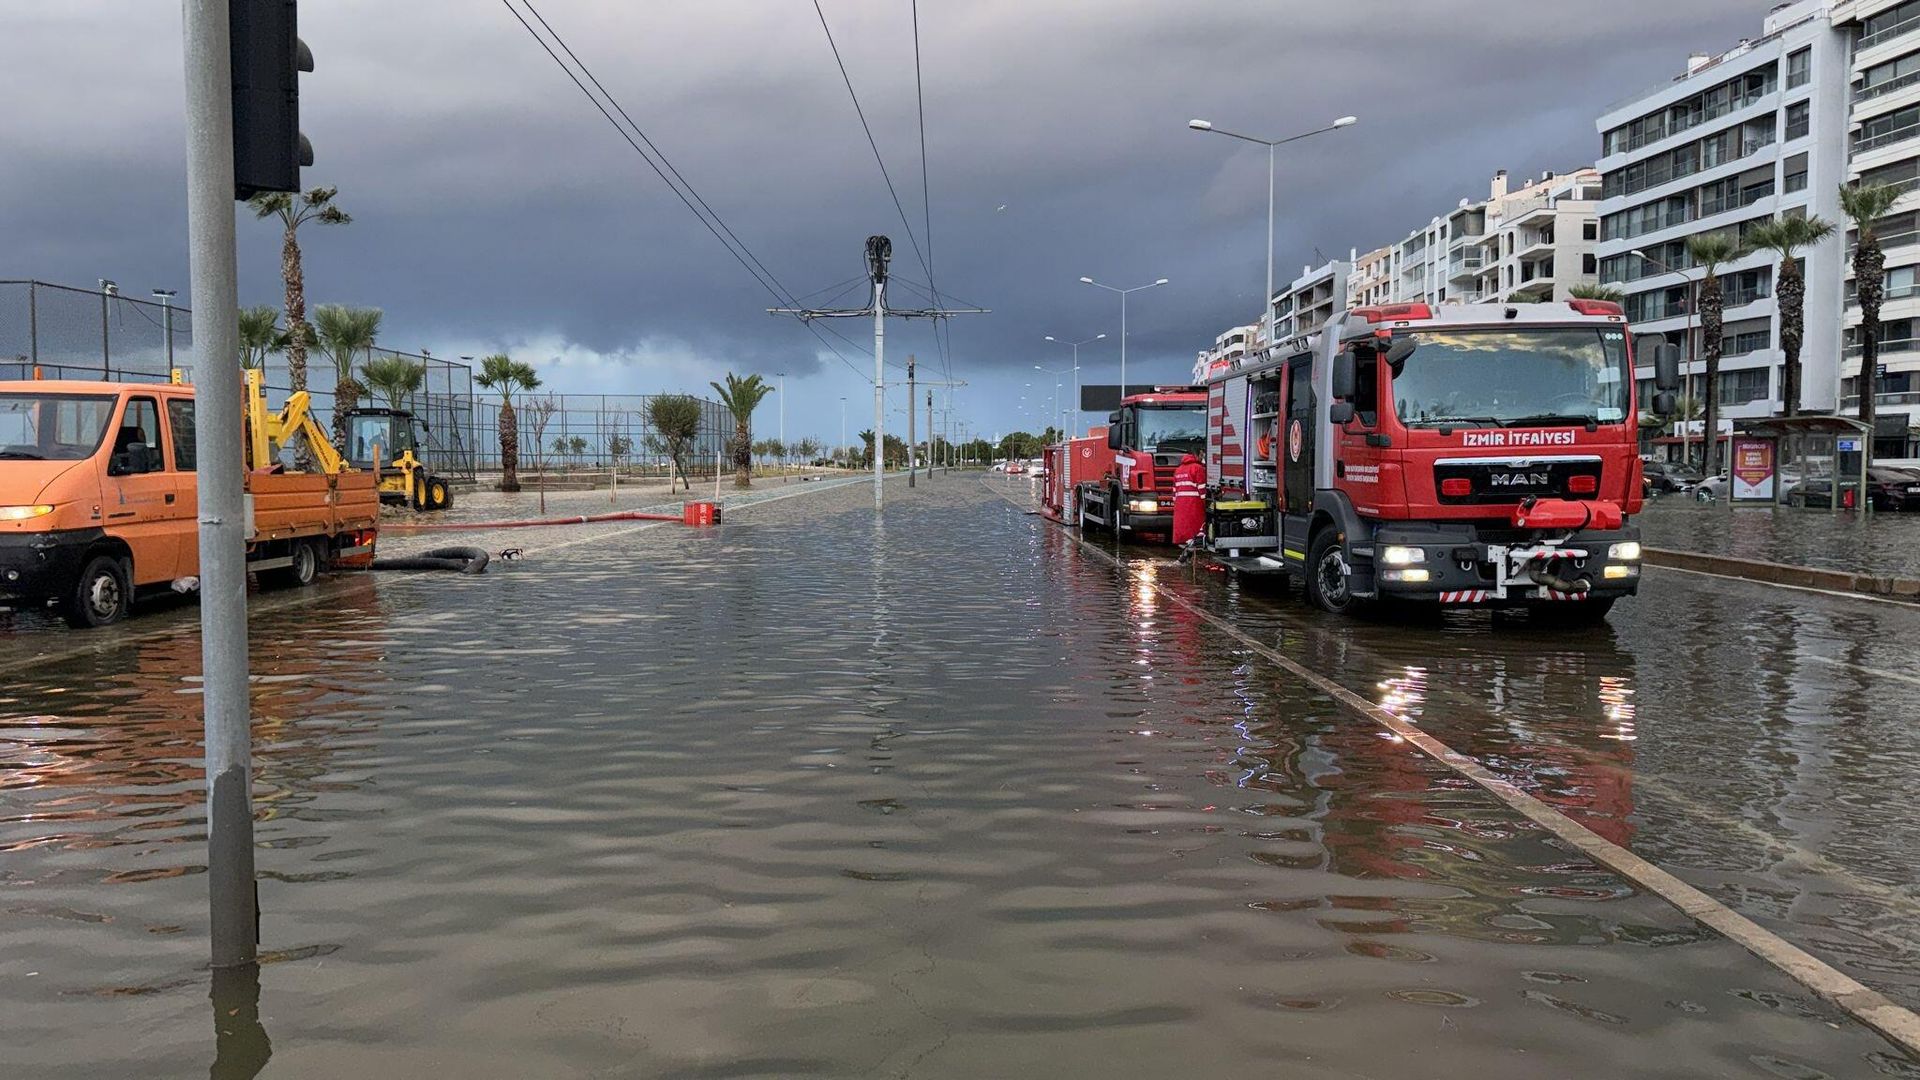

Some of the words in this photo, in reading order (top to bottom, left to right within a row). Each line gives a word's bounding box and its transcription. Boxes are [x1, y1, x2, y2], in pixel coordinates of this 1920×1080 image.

[1463, 431, 1505, 446] İZMİR
[1508, 430, 1575, 445] İTFAİYESİ
[1491, 473, 1548, 486] MAN
